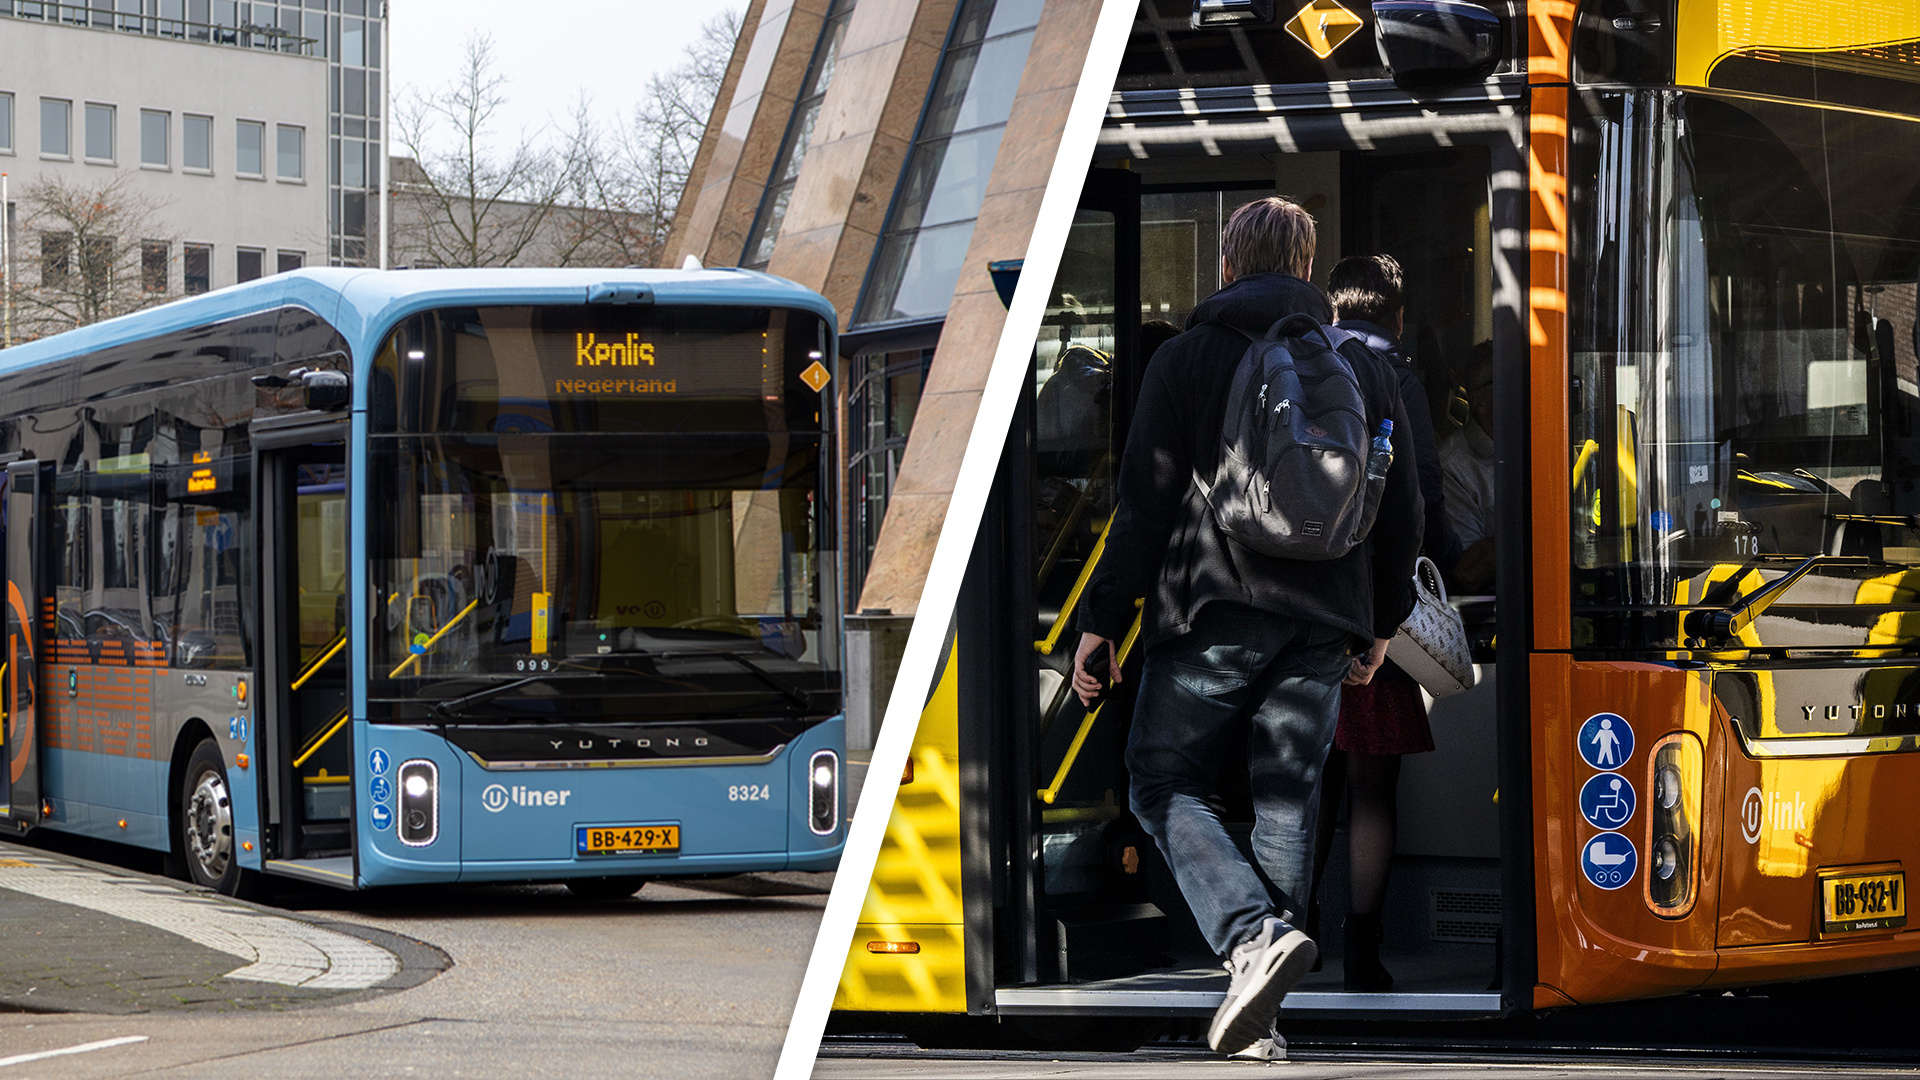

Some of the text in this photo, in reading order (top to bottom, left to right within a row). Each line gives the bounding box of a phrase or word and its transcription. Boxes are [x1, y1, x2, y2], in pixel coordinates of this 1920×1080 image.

[550, 738, 709, 749] YUTONG
[728, 784, 770, 801] 8324
[593, 829, 672, 847] BB-429-X
[1835, 879, 1899, 916] BB-932-V
